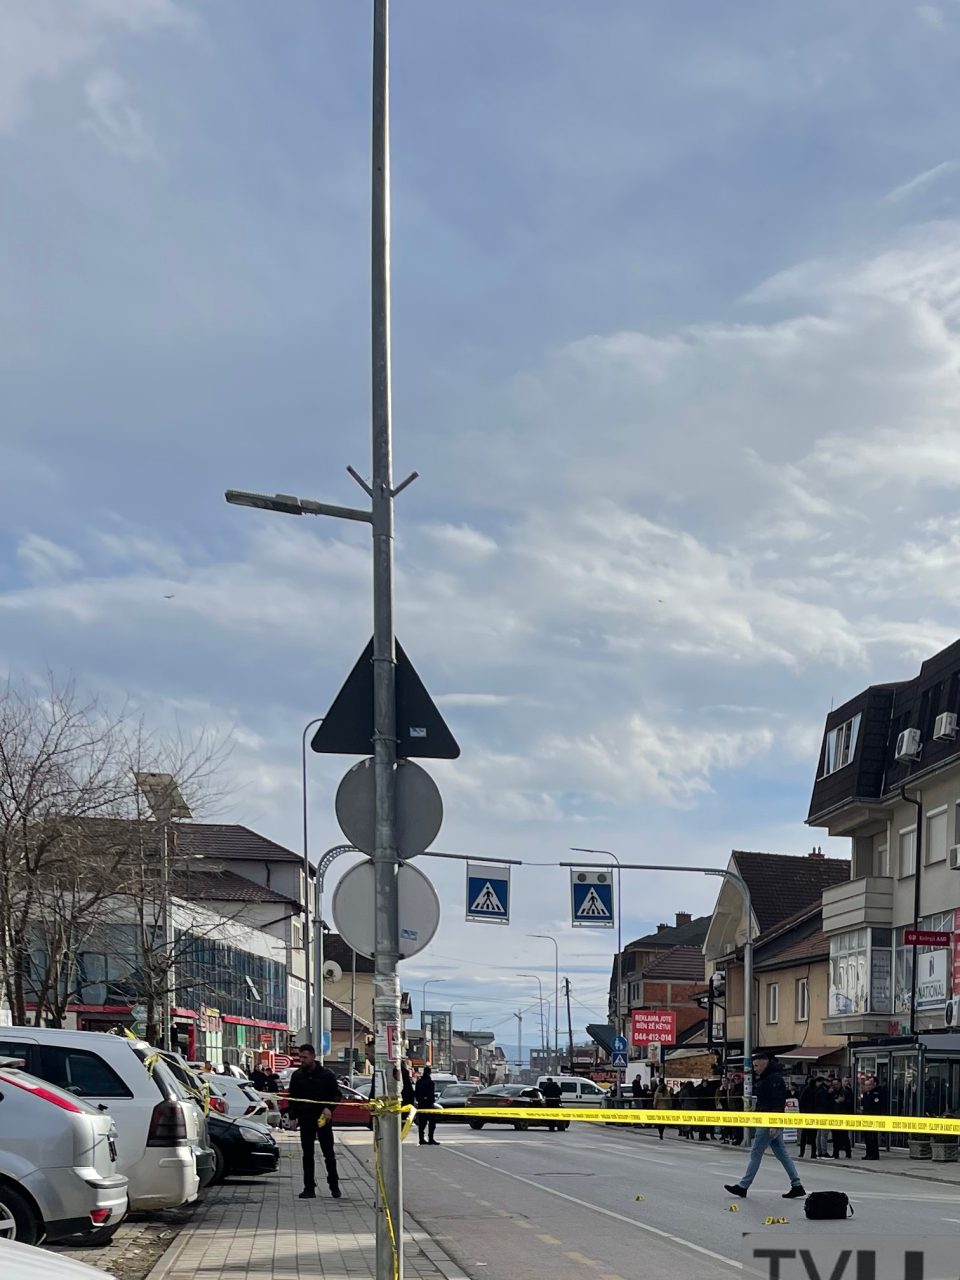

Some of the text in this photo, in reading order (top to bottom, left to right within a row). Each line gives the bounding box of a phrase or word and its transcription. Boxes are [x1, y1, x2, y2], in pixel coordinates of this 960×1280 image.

[918, 984, 945, 999] NATIONAL
[635, 1014, 659, 1022] REKLAMA
[634, 1032, 672, 1041] 044-412-014
